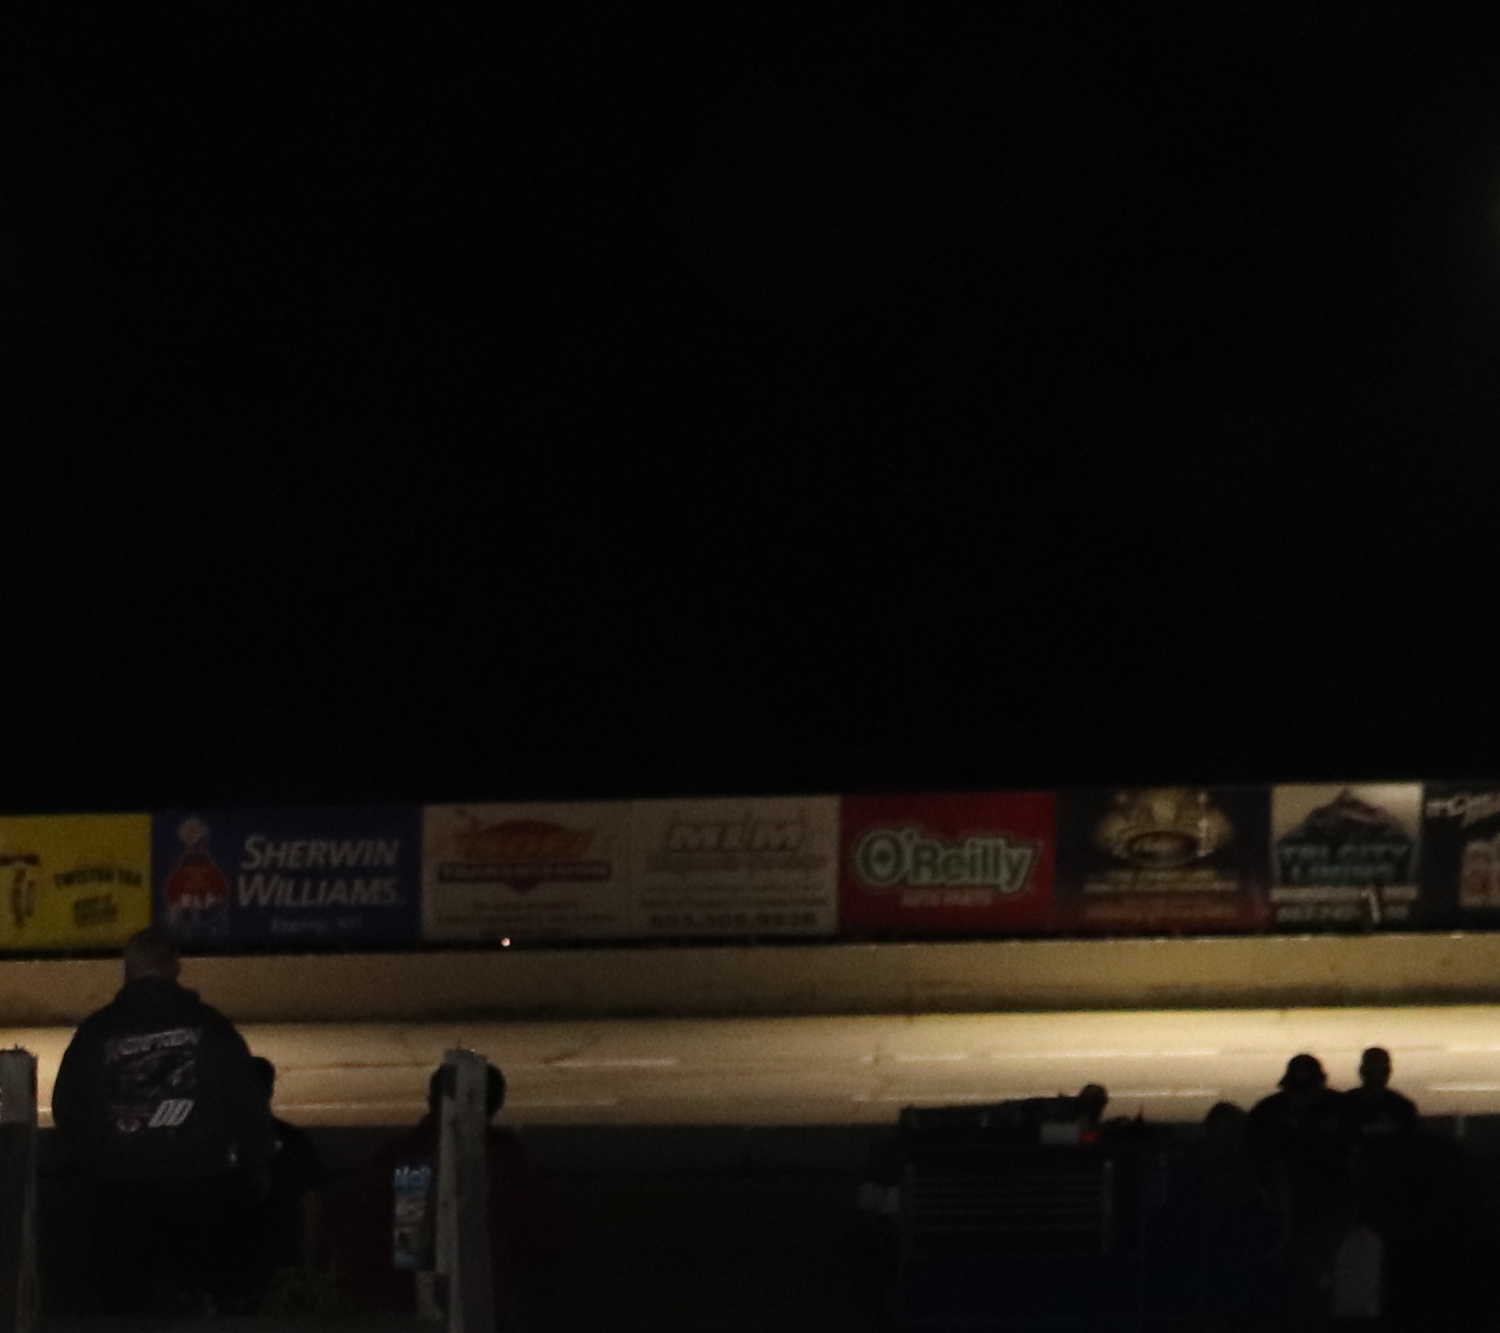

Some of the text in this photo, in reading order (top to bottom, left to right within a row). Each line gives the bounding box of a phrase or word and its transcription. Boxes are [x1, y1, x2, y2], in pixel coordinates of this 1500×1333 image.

[242, 834, 400, 871] SHERWIN
[856, 826, 1041, 894] O'Reilly
[236, 874, 401, 908] WILLIAMS
